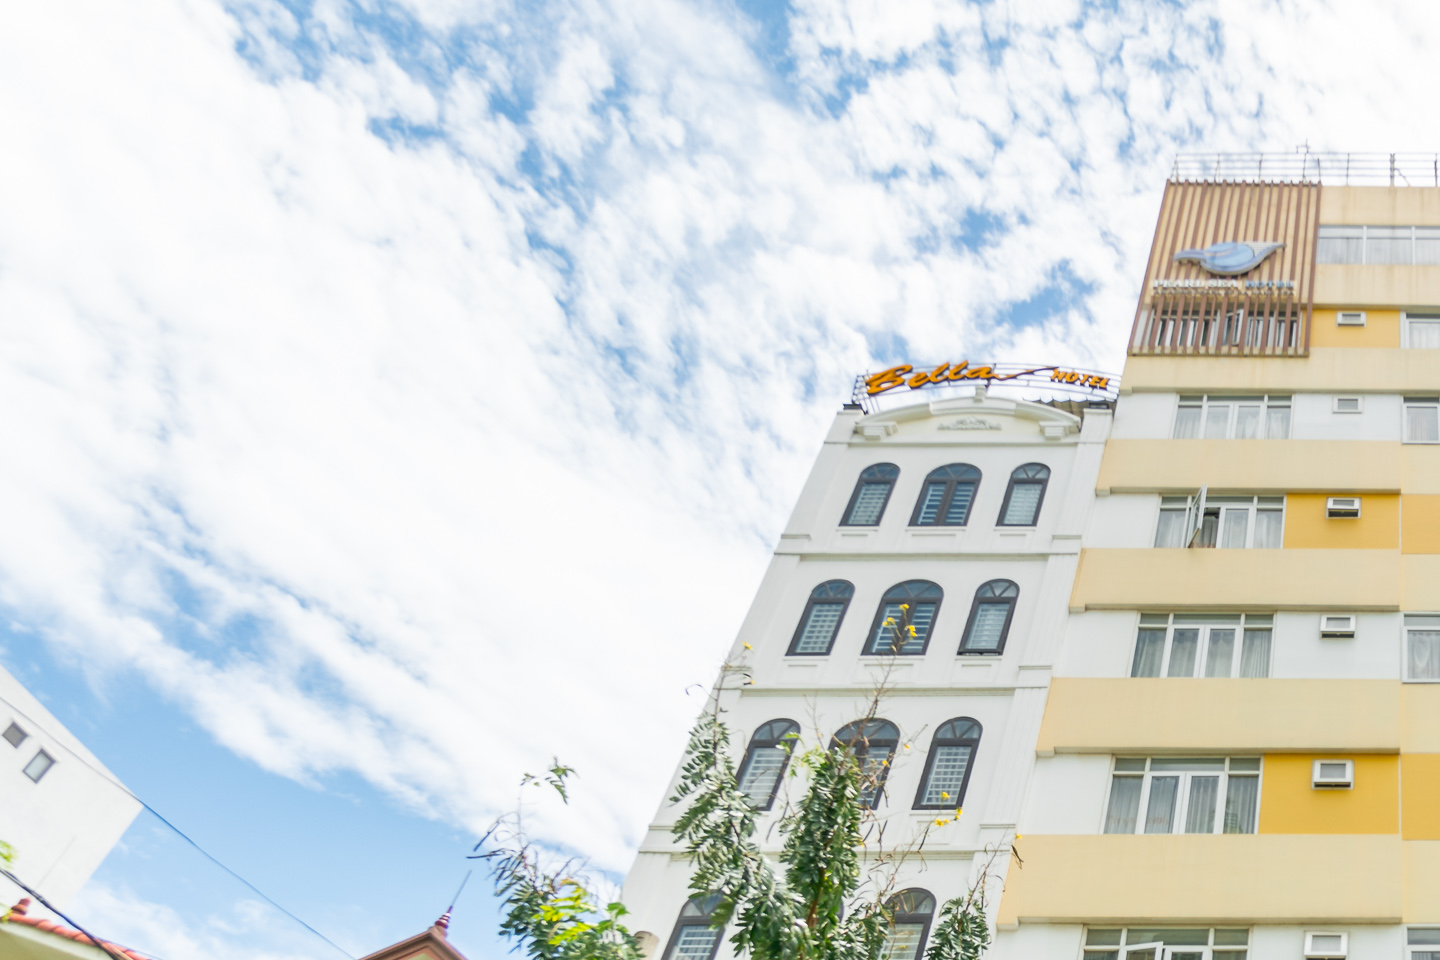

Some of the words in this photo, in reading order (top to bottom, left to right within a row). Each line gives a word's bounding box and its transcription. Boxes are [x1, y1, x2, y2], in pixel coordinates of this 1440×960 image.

[1153, 279, 1205, 289] PEARL
[1208, 279, 1239, 289] SEA
[865, 360, 1058, 396] Bella
[1050, 366, 1110, 391] HOTEL
